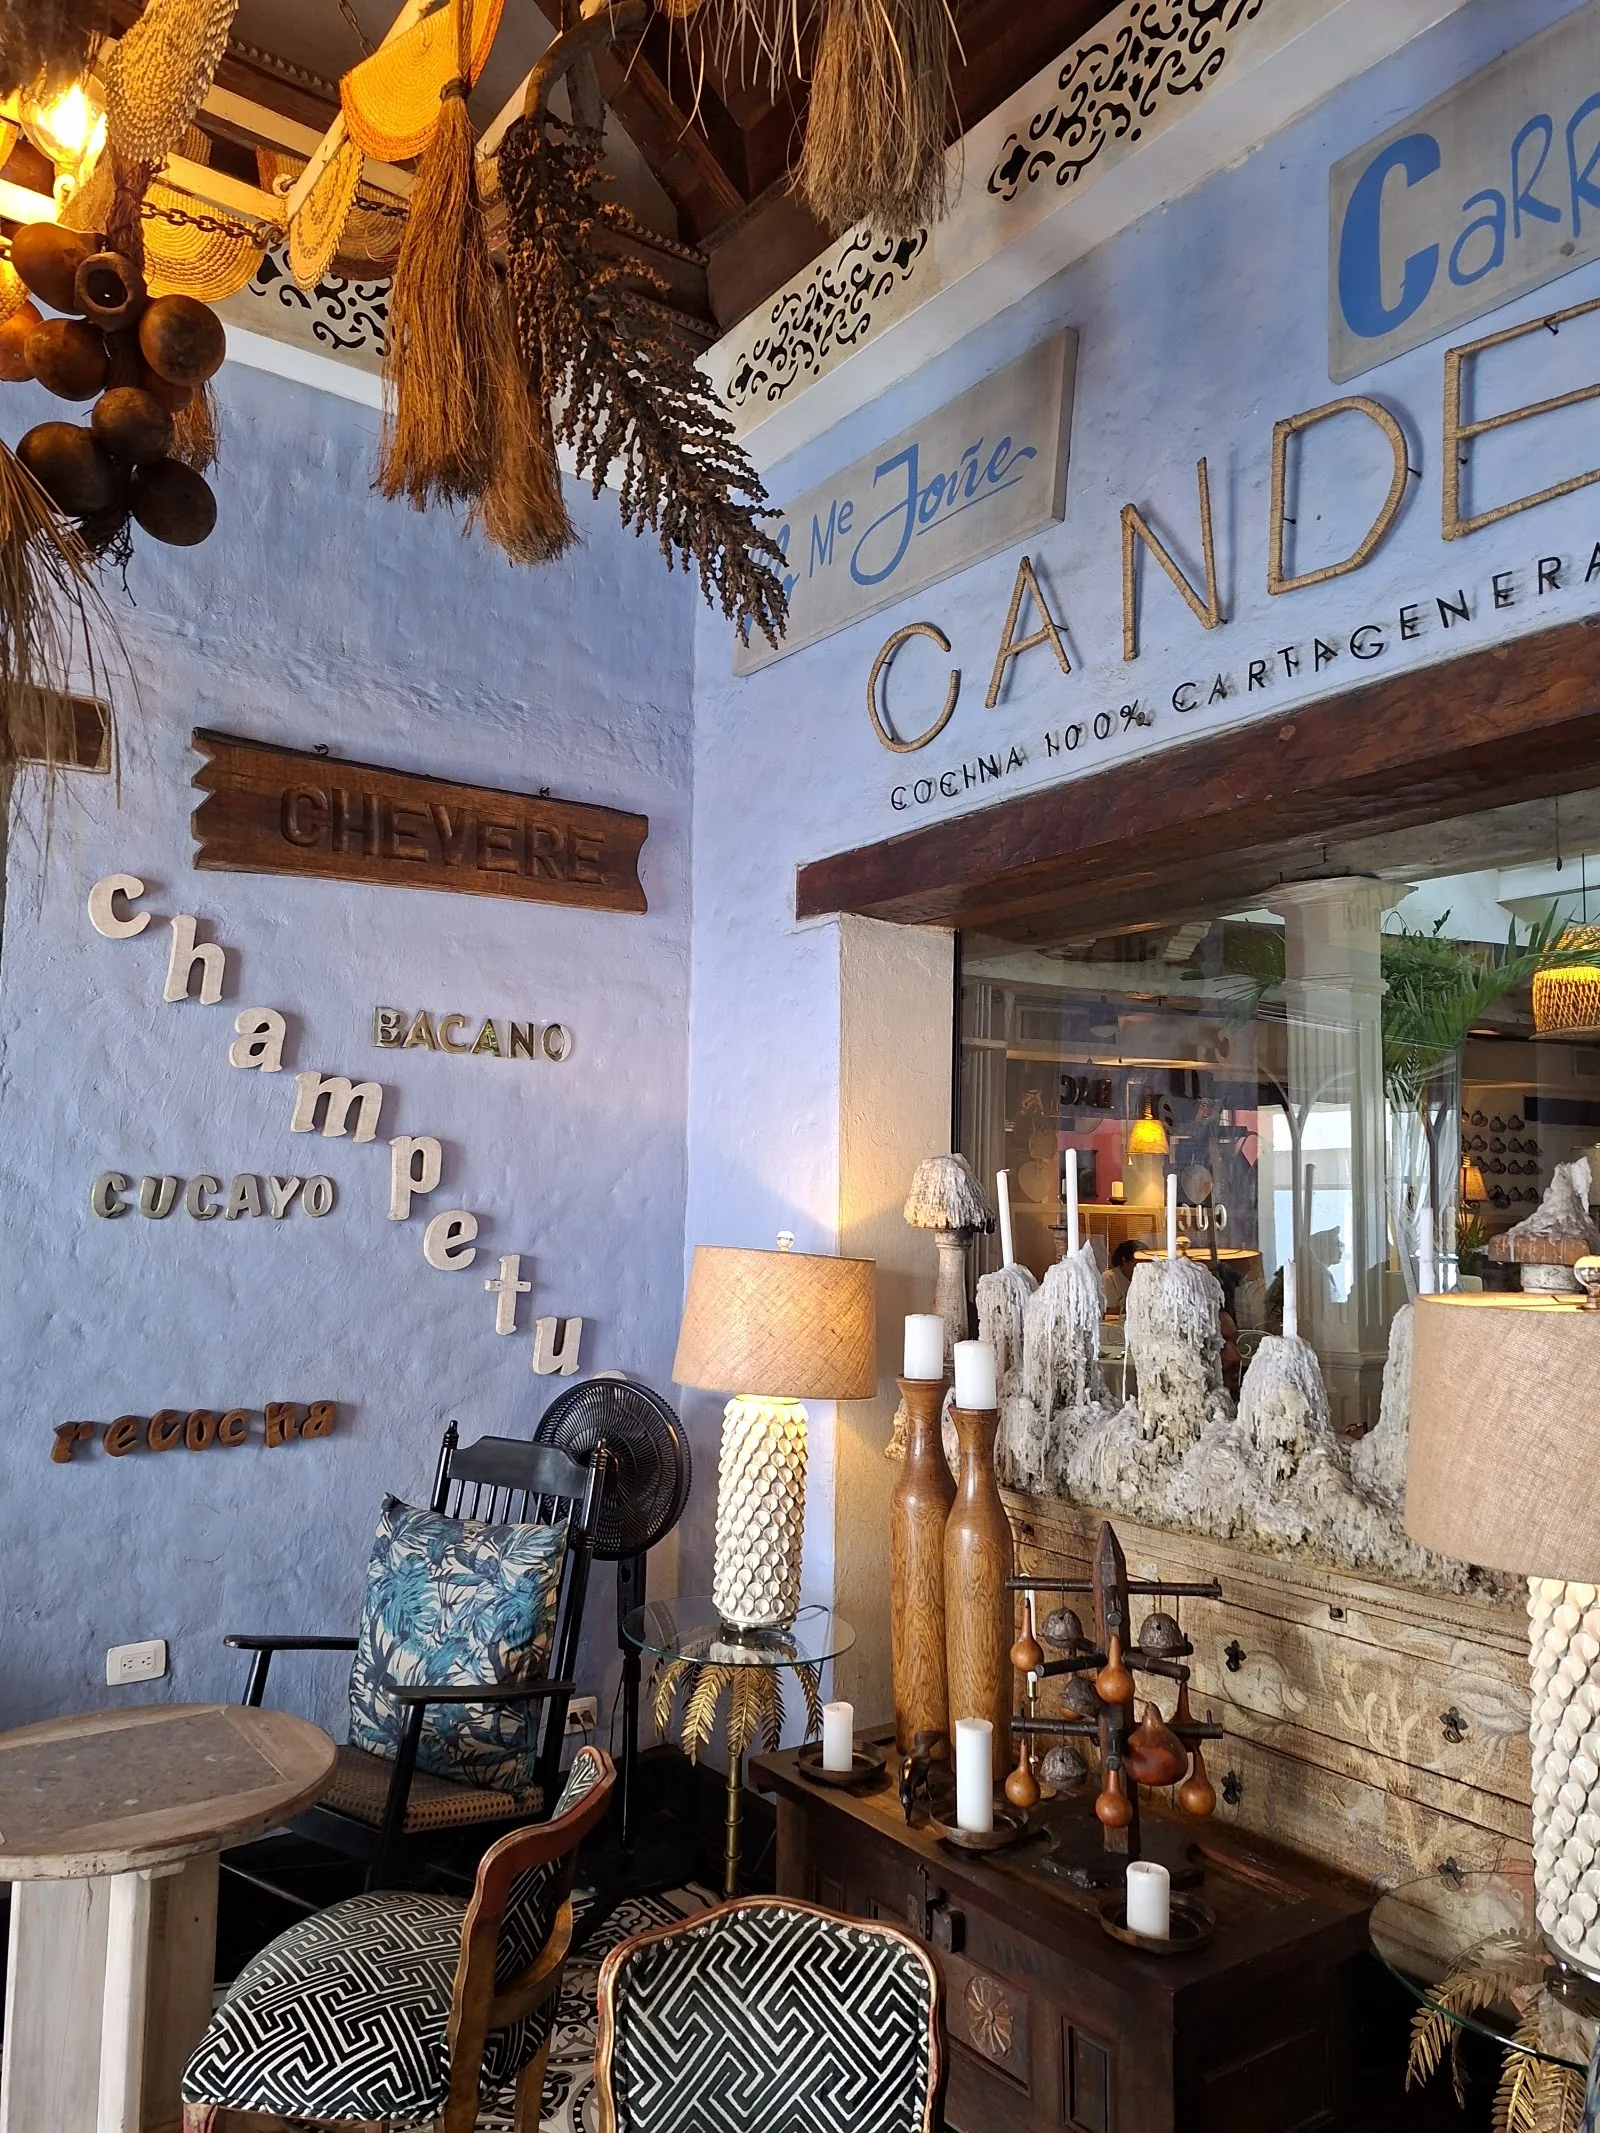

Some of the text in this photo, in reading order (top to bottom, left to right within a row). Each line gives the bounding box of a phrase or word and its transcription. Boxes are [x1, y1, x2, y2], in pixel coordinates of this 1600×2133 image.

[809, 499, 854, 578] Me
[891, 541, 1600, 810] COCINA 100% CARTAGENERA
[279, 782, 607, 885] CHEVERE
[372, 1006, 573, 1062] BACANO
[91, 1171, 334, 1221] CUCAYO
